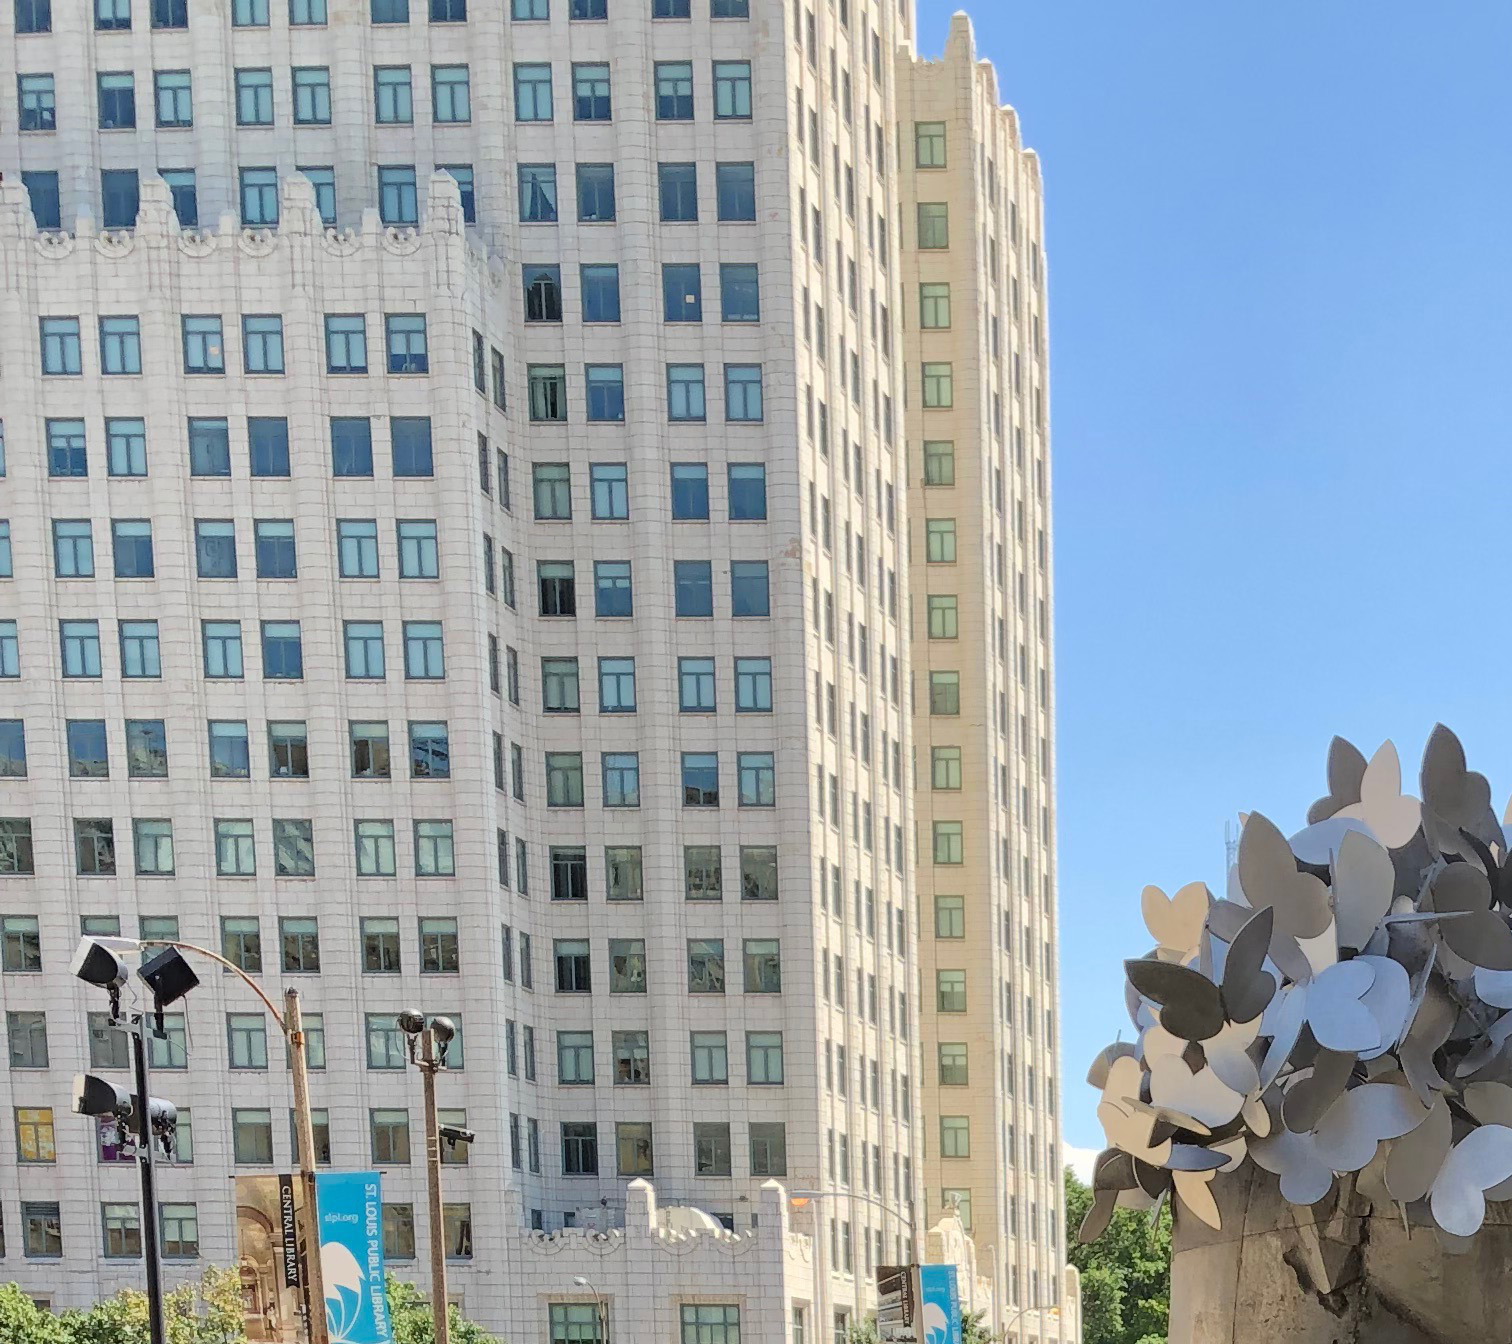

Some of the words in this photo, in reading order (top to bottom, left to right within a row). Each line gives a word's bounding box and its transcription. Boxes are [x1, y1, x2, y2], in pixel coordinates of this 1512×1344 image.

[281, 1185, 293, 1237] CENTRAL
[364, 1183, 377, 1200] ST.
[324, 1212, 359, 1224] slpl.org
[366, 1202, 378, 1237] LOUIS
[285, 1238, 298, 1282] LIBRARY
[367, 1240, 381, 1282] PUBLIC
[370, 1285, 389, 1338] LIBRARY
